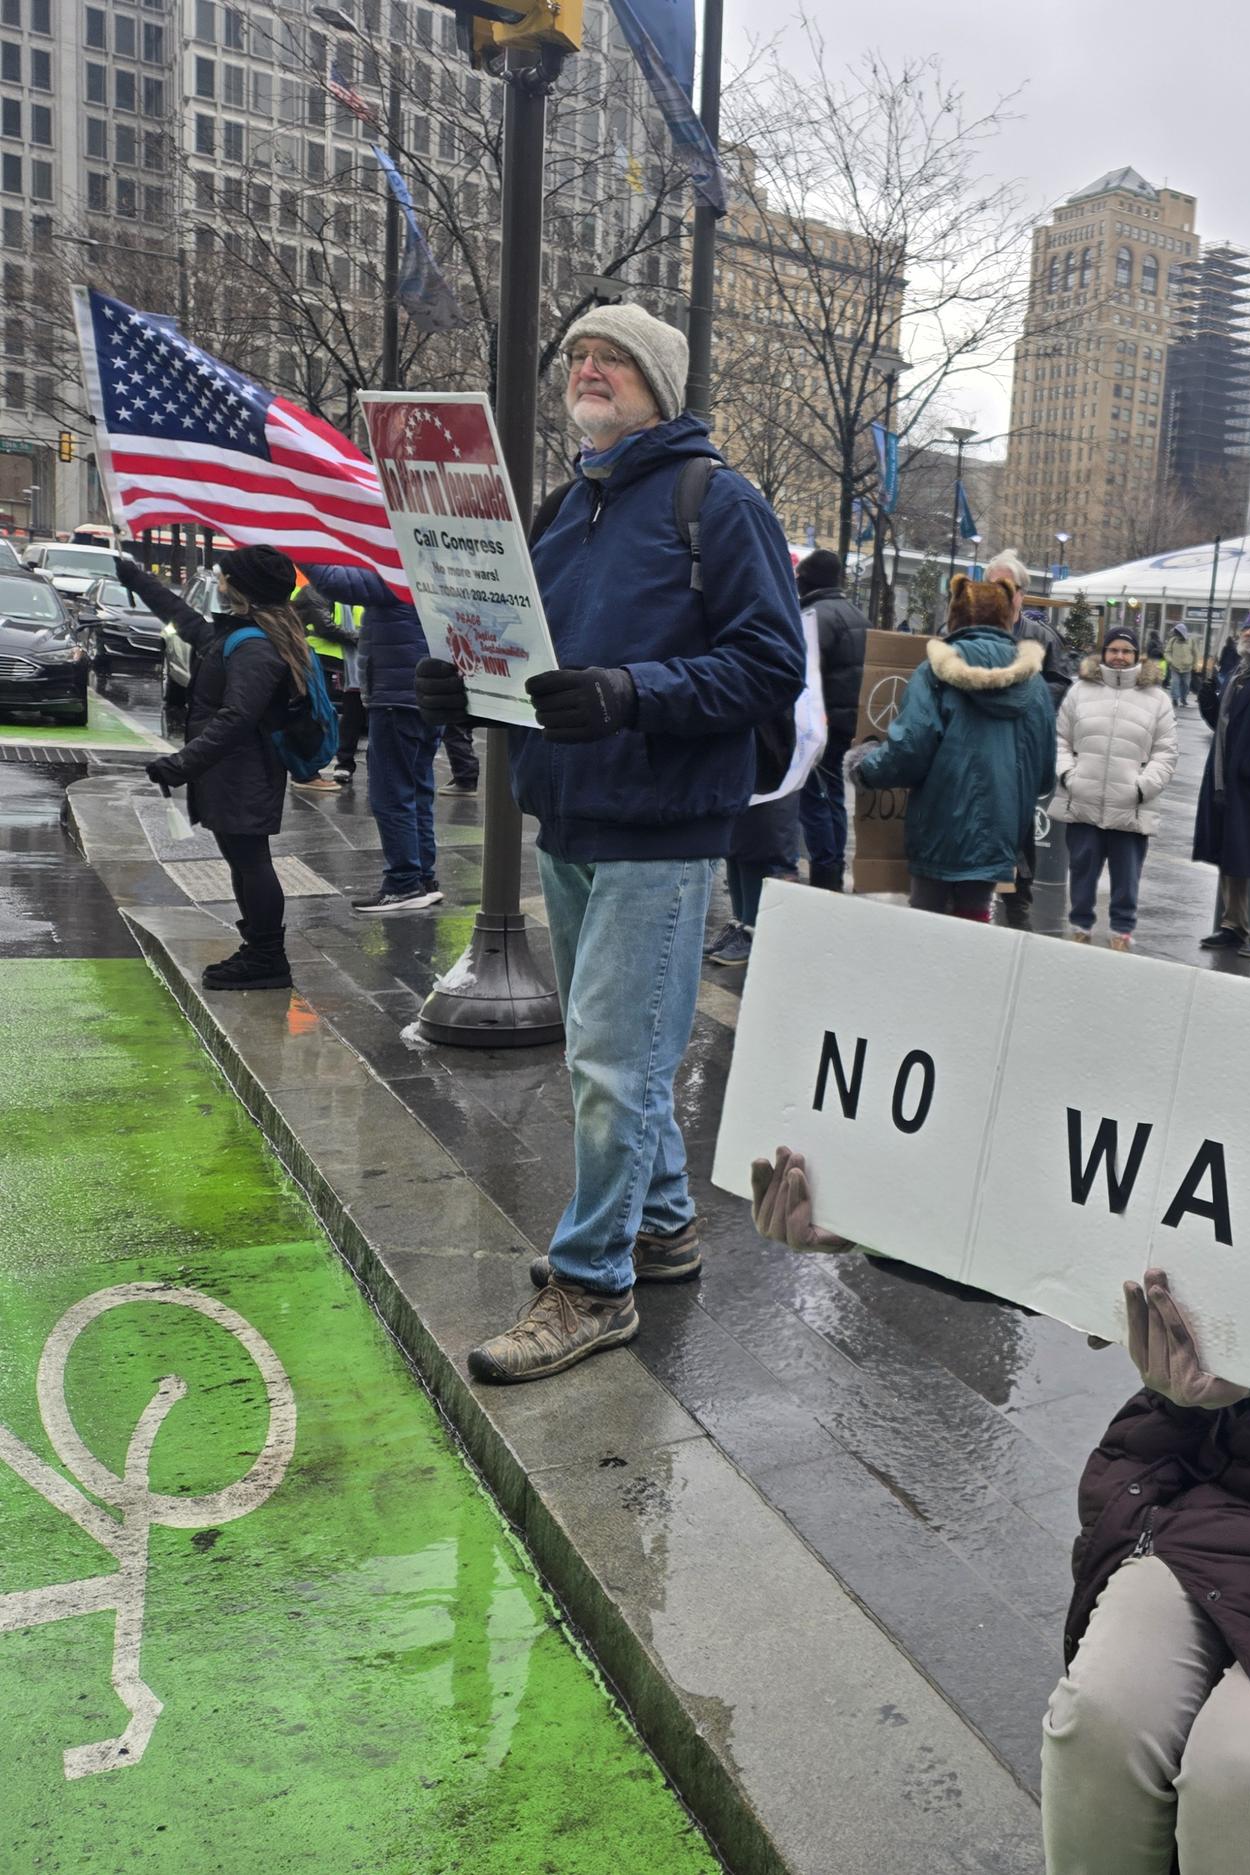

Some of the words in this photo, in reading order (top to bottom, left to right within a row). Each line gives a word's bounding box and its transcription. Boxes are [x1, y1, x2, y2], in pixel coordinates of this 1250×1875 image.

[394, 459, 430, 514] War
[436, 460, 512, 522] Venezuela
[413, 528, 440, 548] Call
[440, 531, 505, 556] Congress
[432, 561, 446, 575] No
[447, 565, 471, 578] more
[473, 568, 500, 581] wars!
[415, 581, 439, 595] CALL
[471, 588, 531, 608] 202-224-3121
[481, 656, 511, 678] NOW!
[812, 1030, 936, 1135] NO
